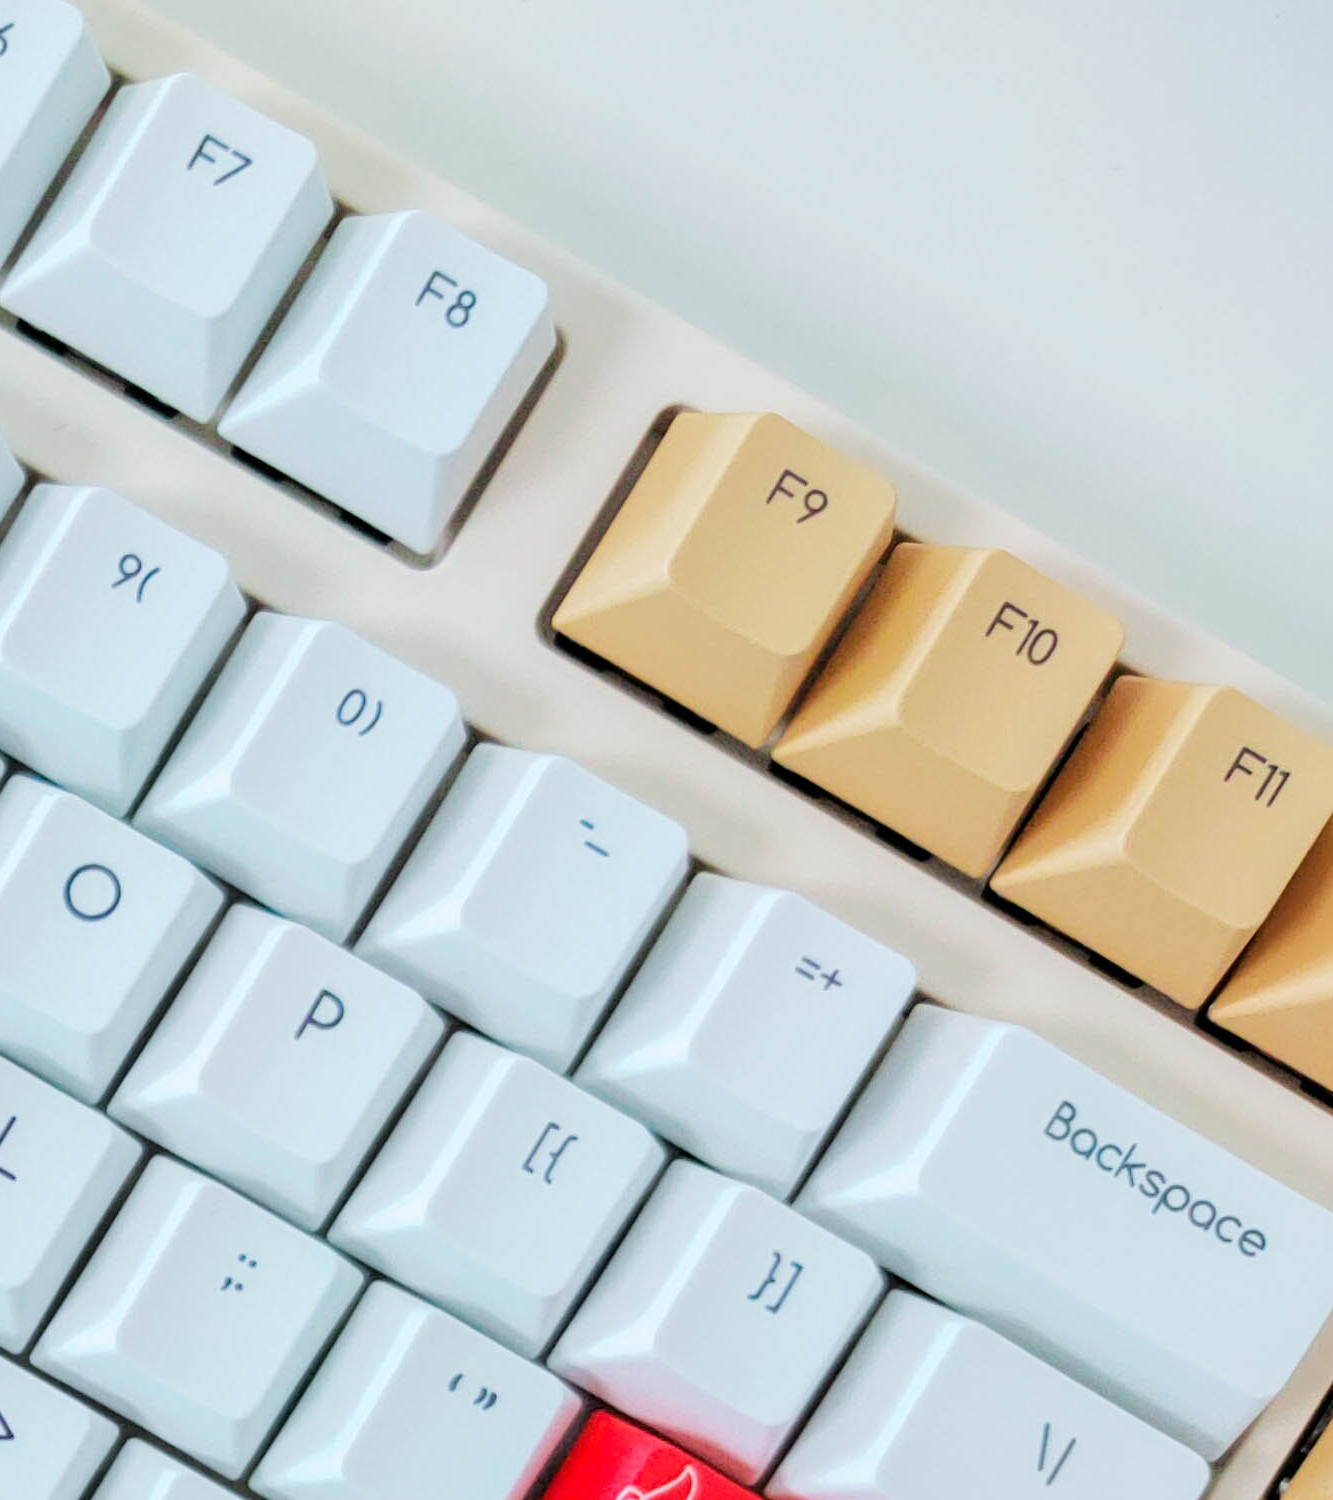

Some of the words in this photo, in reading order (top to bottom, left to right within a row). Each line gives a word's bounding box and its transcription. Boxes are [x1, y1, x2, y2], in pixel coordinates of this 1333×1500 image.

[187, 133, 253, 186] F7
[415, 269, 477, 329] F8
[766, 469, 829, 524] F9
[985, 601, 1059, 666] F10
[1223, 746, 1291, 808] F11
[63, 863, 122, 922] O
[795, 956, 843, 991] =+
[294, 988, 345, 1039] P
[1043, 1100, 1267, 1258] Backspace
